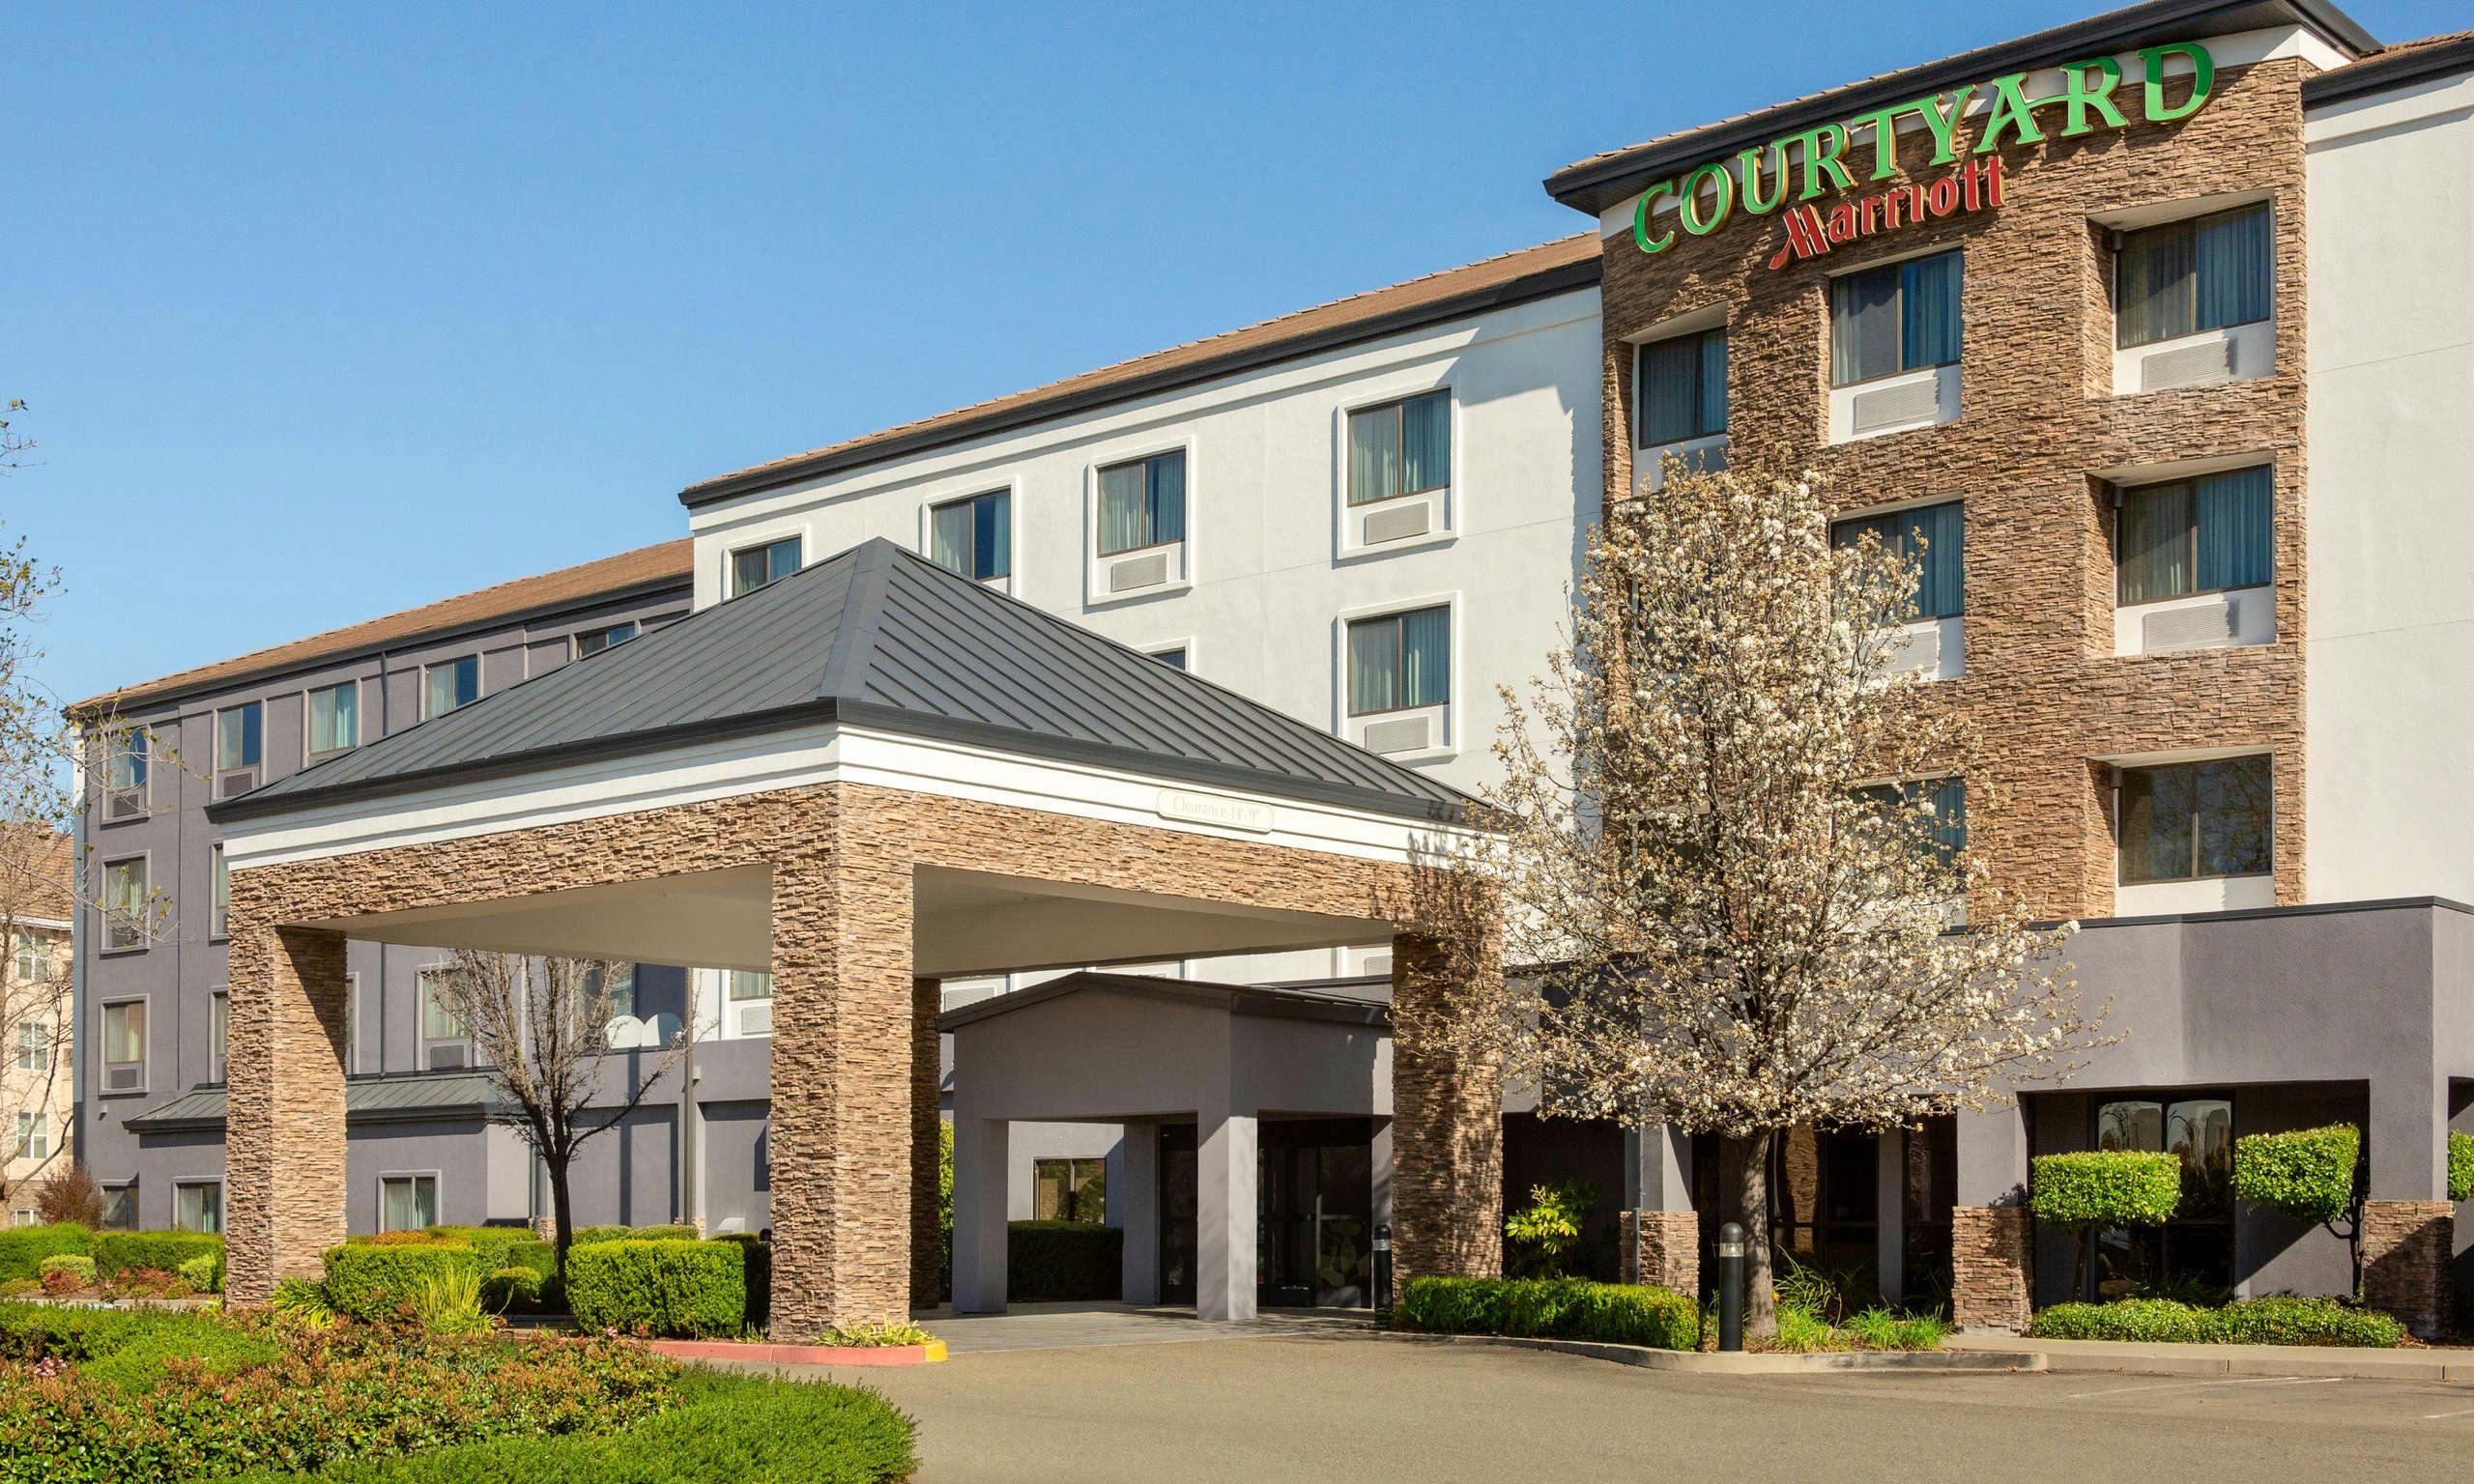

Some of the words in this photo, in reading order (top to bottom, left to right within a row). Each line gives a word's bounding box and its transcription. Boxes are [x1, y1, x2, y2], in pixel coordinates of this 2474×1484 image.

[1633, 42, 2215, 253] COURTYARD
[1769, 155, 2006, 271] Marriott
[1173, 795, 1227, 817] Clearance
